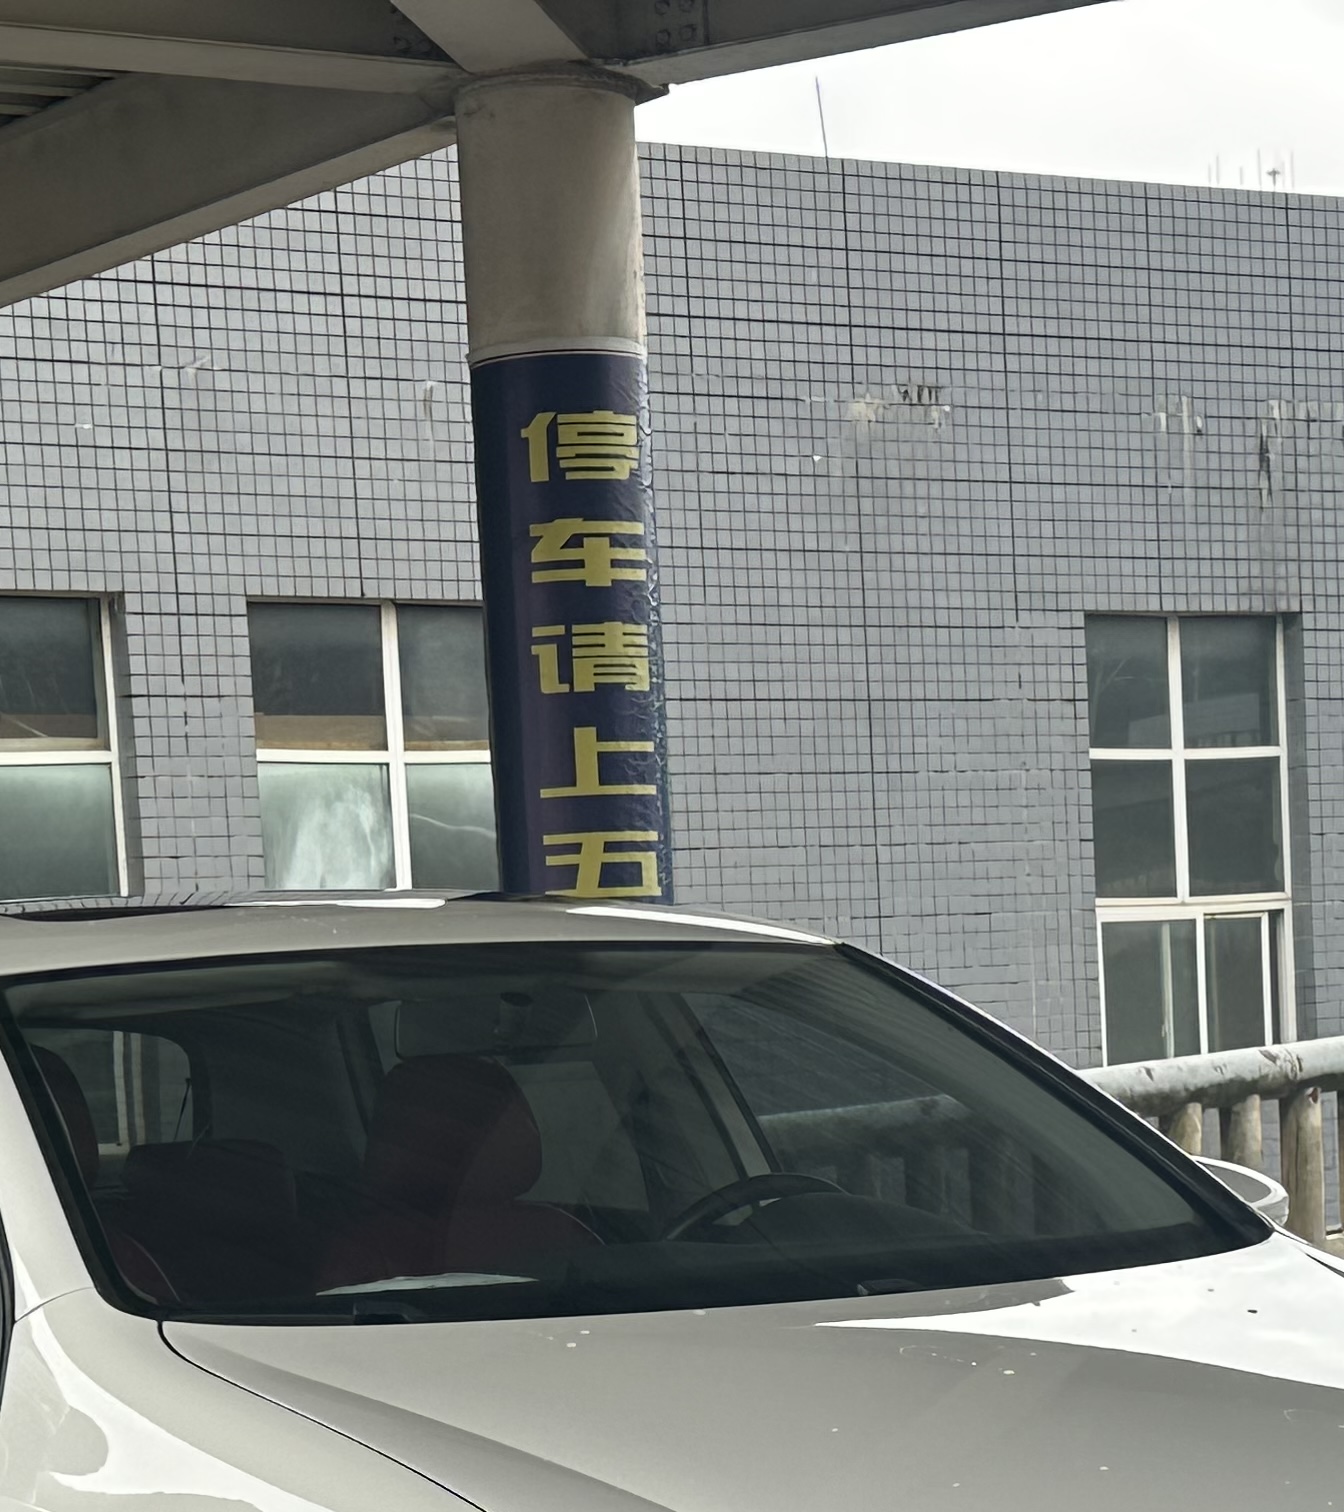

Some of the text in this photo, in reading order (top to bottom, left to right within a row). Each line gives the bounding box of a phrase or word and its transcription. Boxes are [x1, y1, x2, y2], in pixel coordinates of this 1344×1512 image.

[520, 410, 662, 898] 停车请上五
